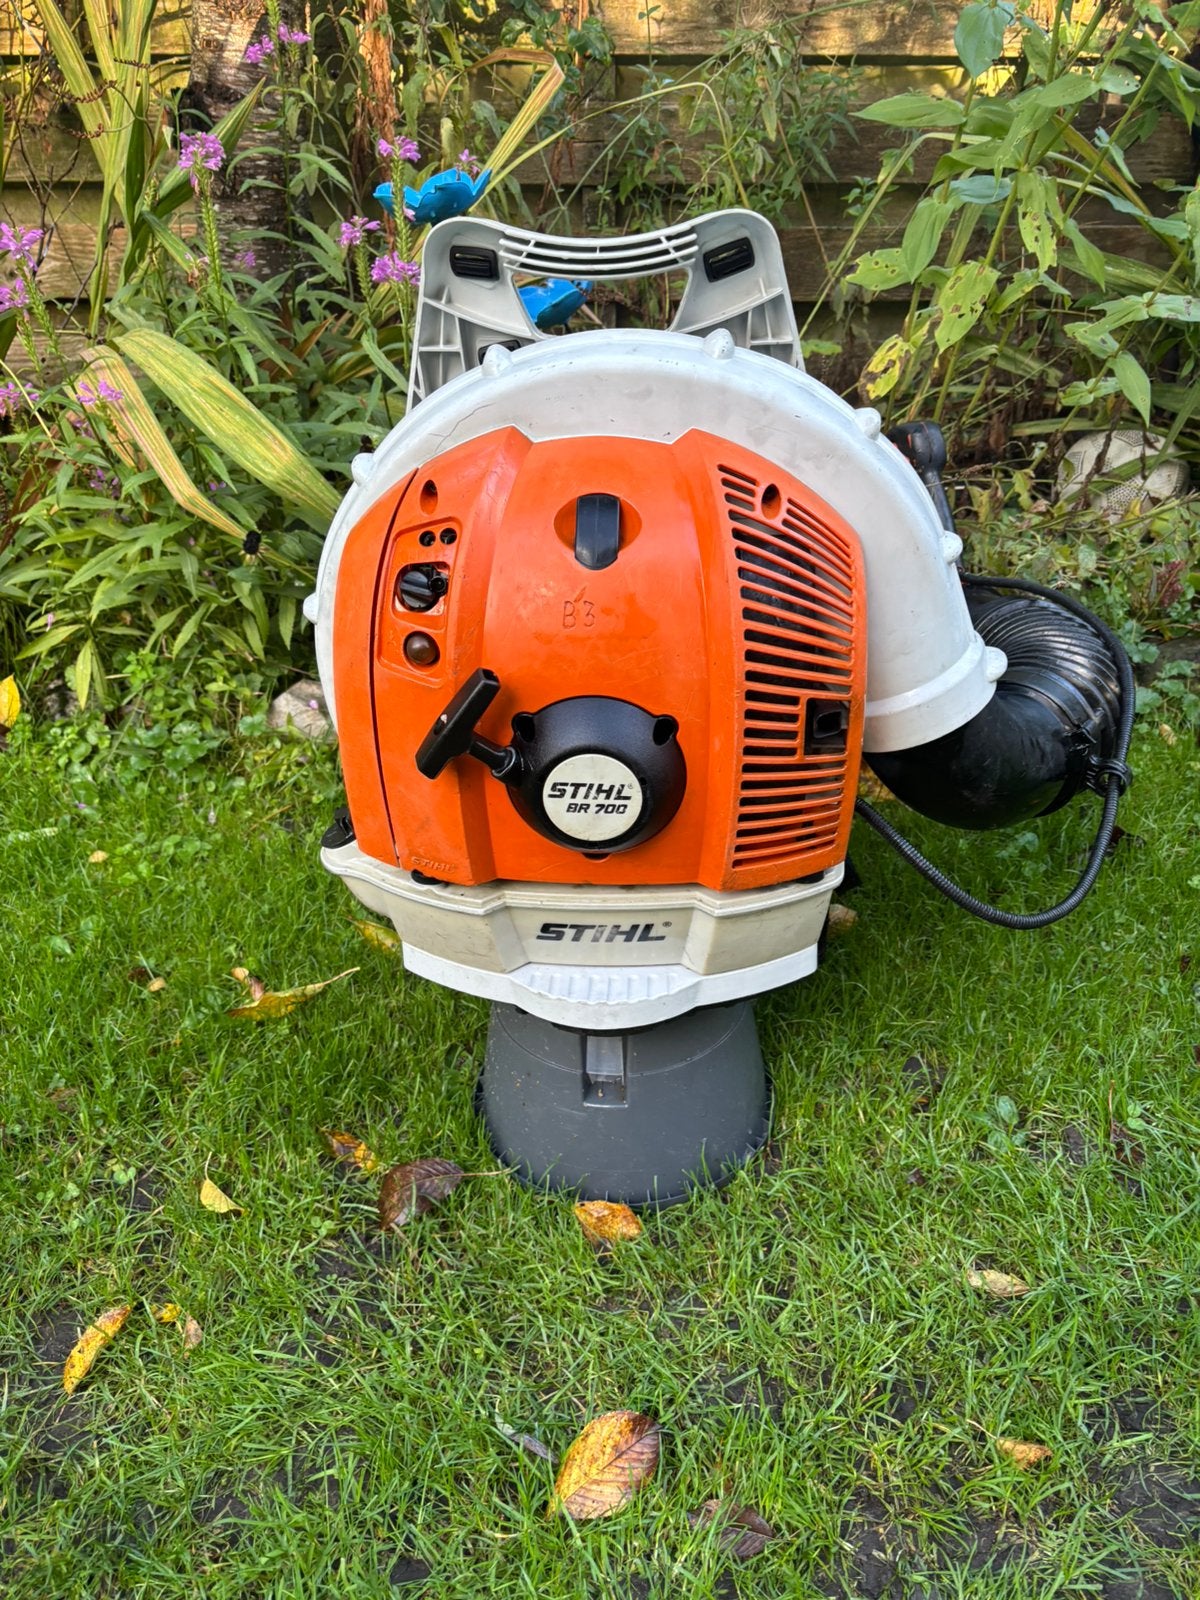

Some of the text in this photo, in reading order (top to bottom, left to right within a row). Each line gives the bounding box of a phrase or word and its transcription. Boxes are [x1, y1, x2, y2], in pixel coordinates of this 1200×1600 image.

[566, 803, 628, 815] BR 700
[410, 856, 455, 873] STIHL
